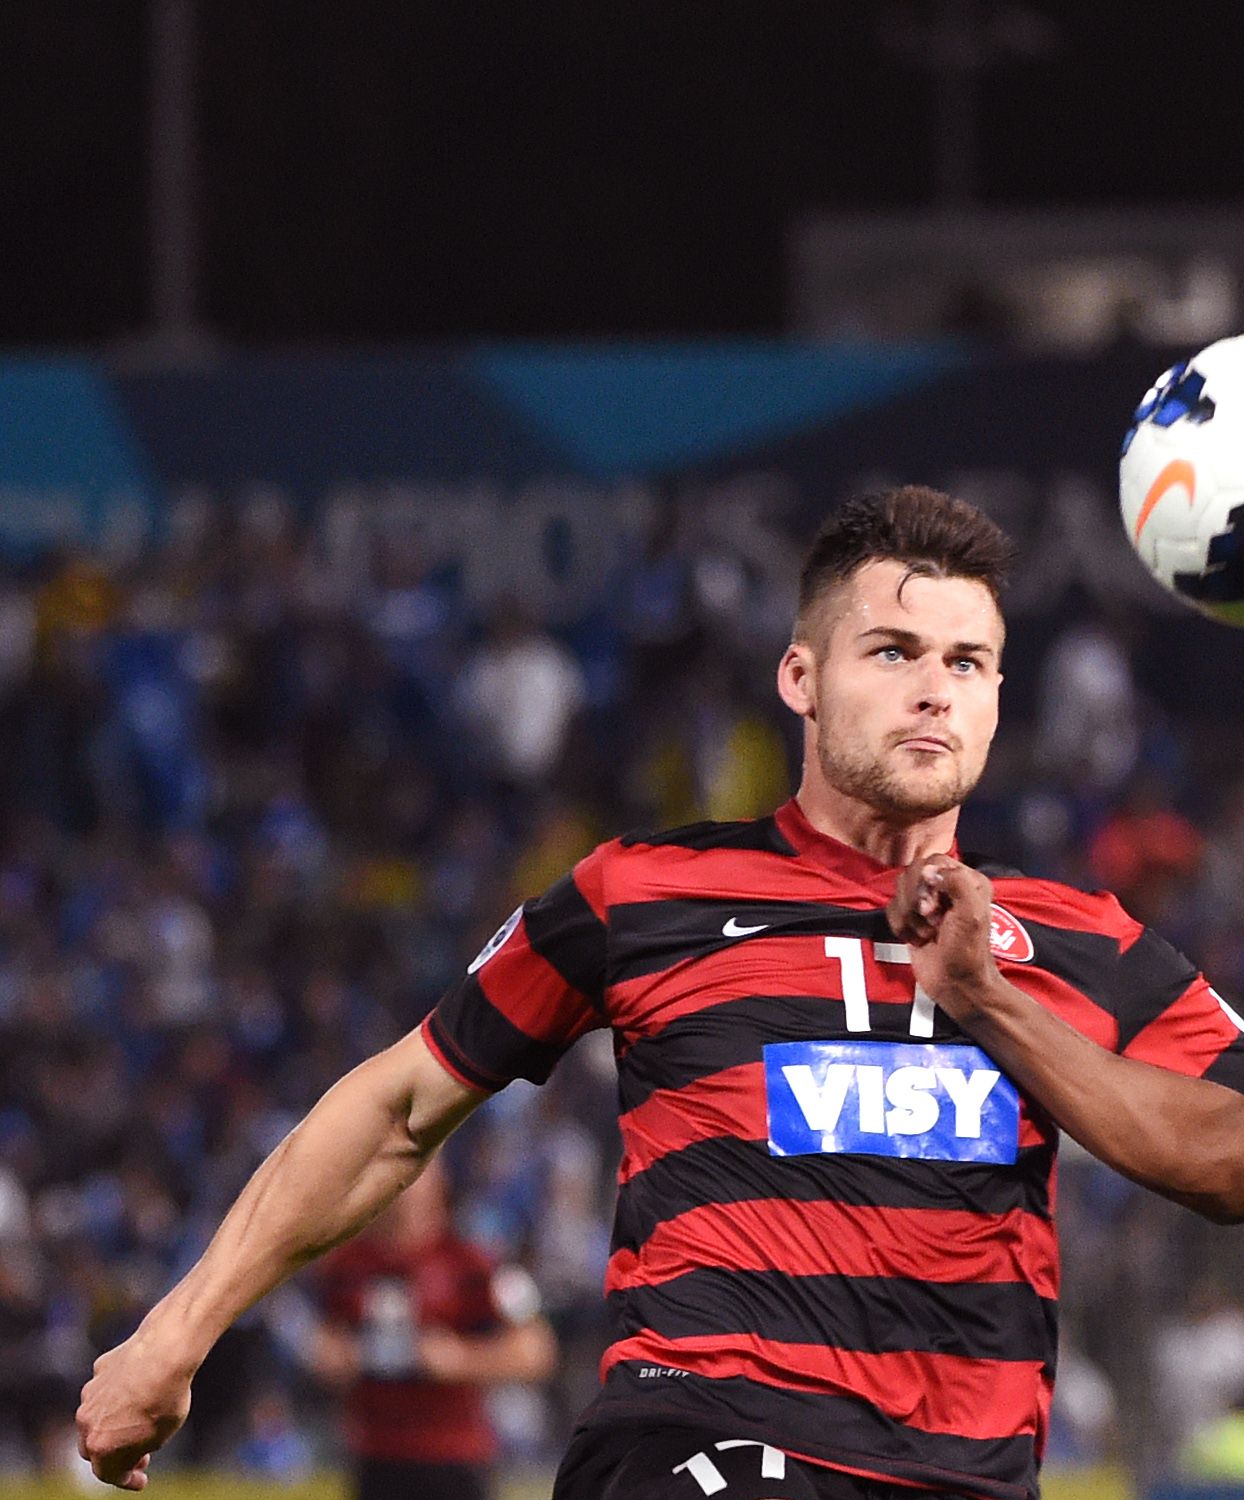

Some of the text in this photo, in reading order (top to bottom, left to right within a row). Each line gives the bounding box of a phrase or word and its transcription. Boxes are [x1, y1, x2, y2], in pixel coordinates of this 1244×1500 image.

[823, 936, 935, 1038] 17
[781, 1064, 1001, 1139] VISY
[638, 1367, 691, 1379] DRI-FIT
[671, 1439, 786, 1496] 17
